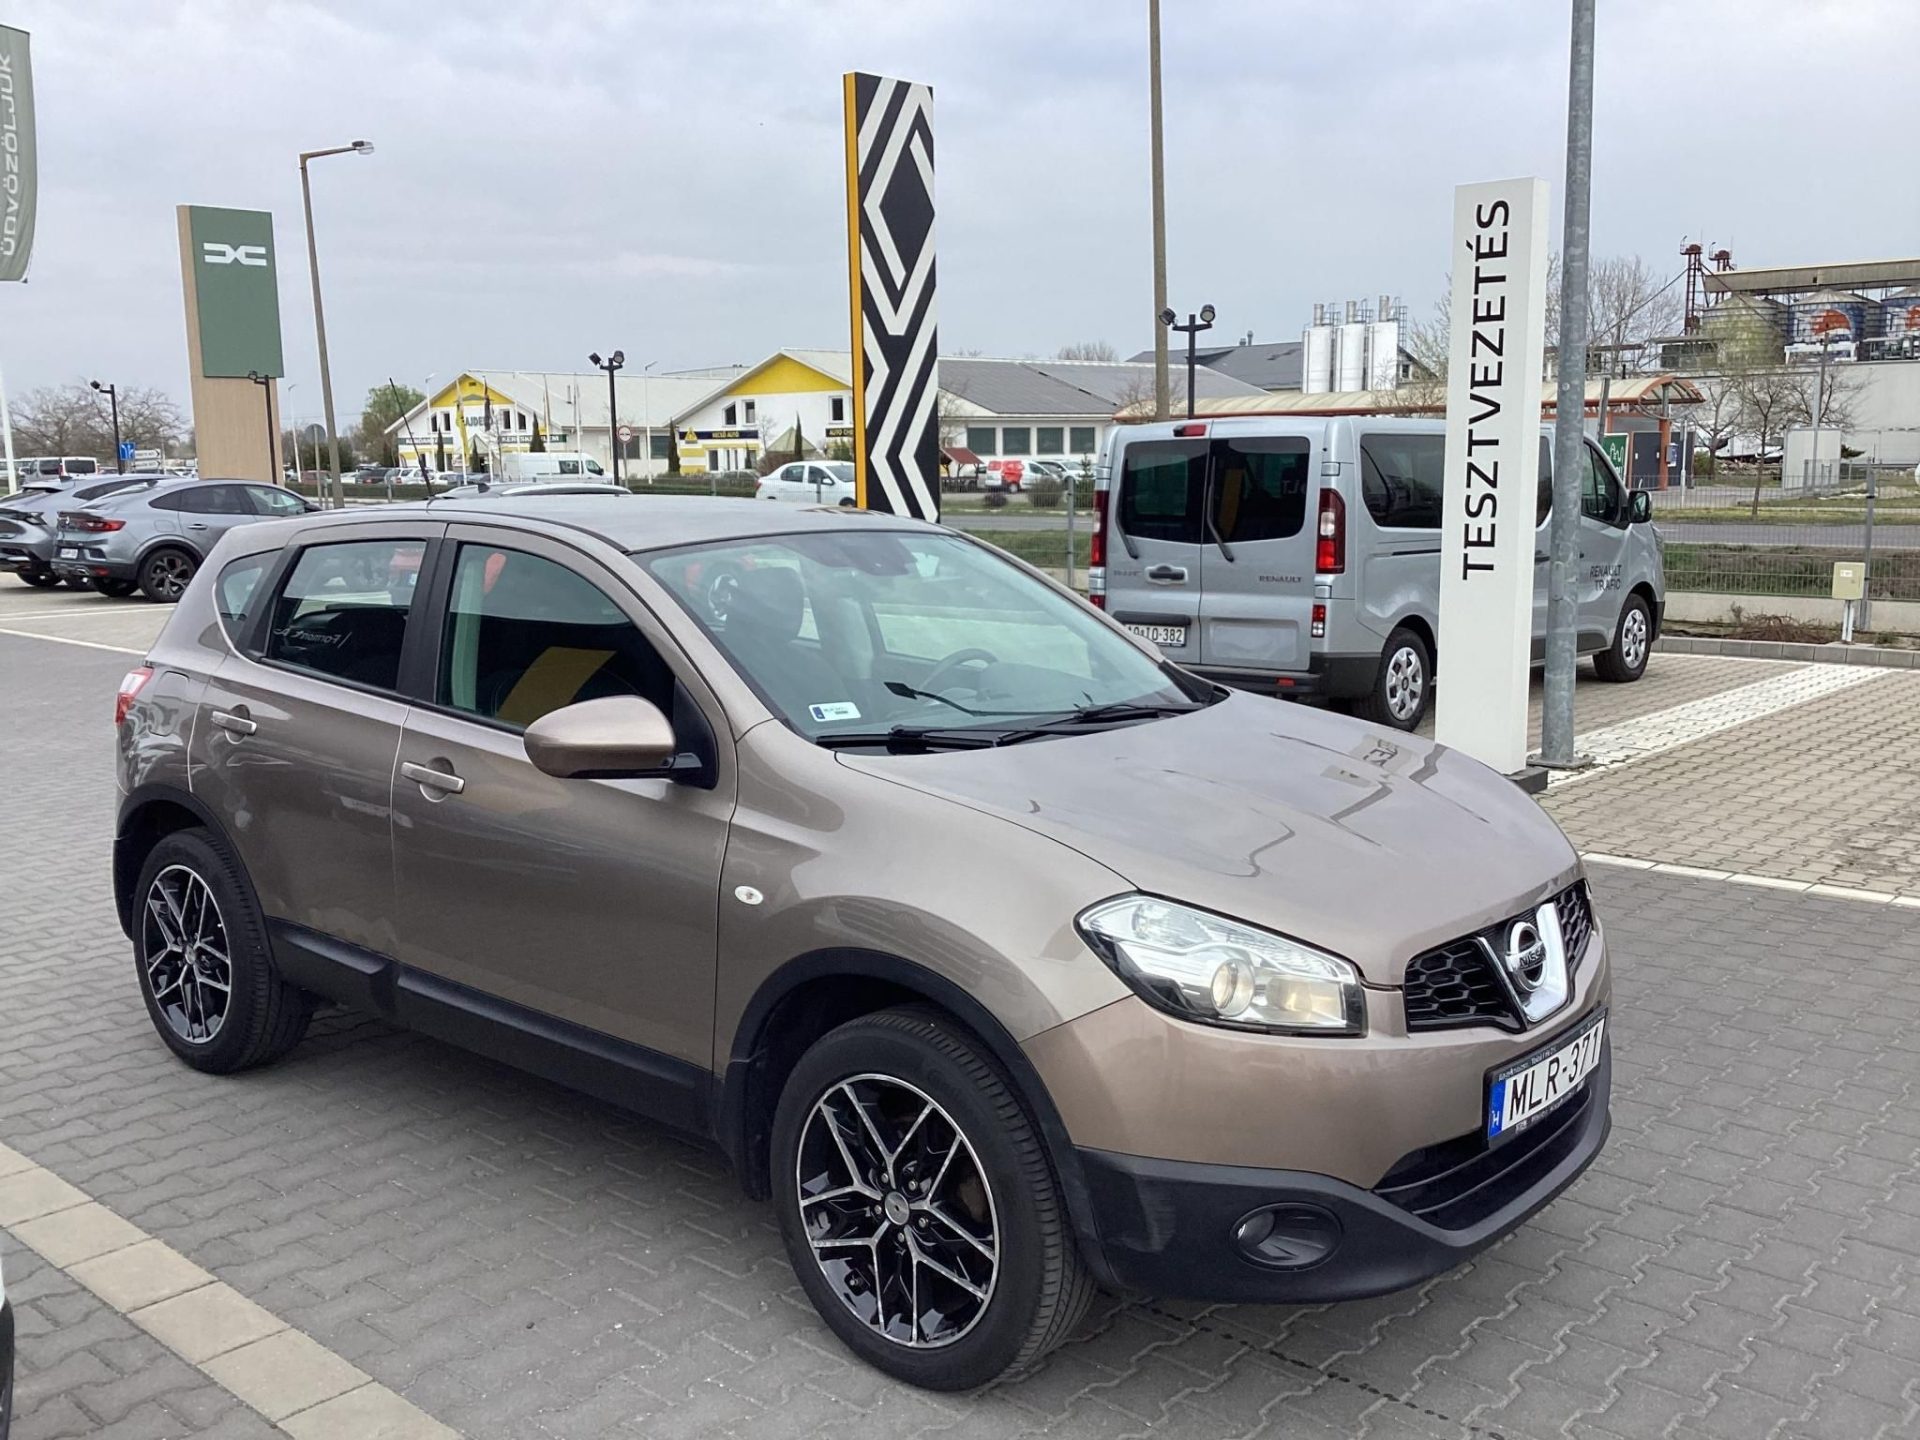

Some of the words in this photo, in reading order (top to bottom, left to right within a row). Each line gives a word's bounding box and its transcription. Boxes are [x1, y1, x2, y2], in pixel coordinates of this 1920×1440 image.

[1462, 199, 1509, 581] TESZTVEZETÉS
[1259, 575, 1301, 583] RENAULT
[1509, 1026, 1599, 1121] MLR-371
